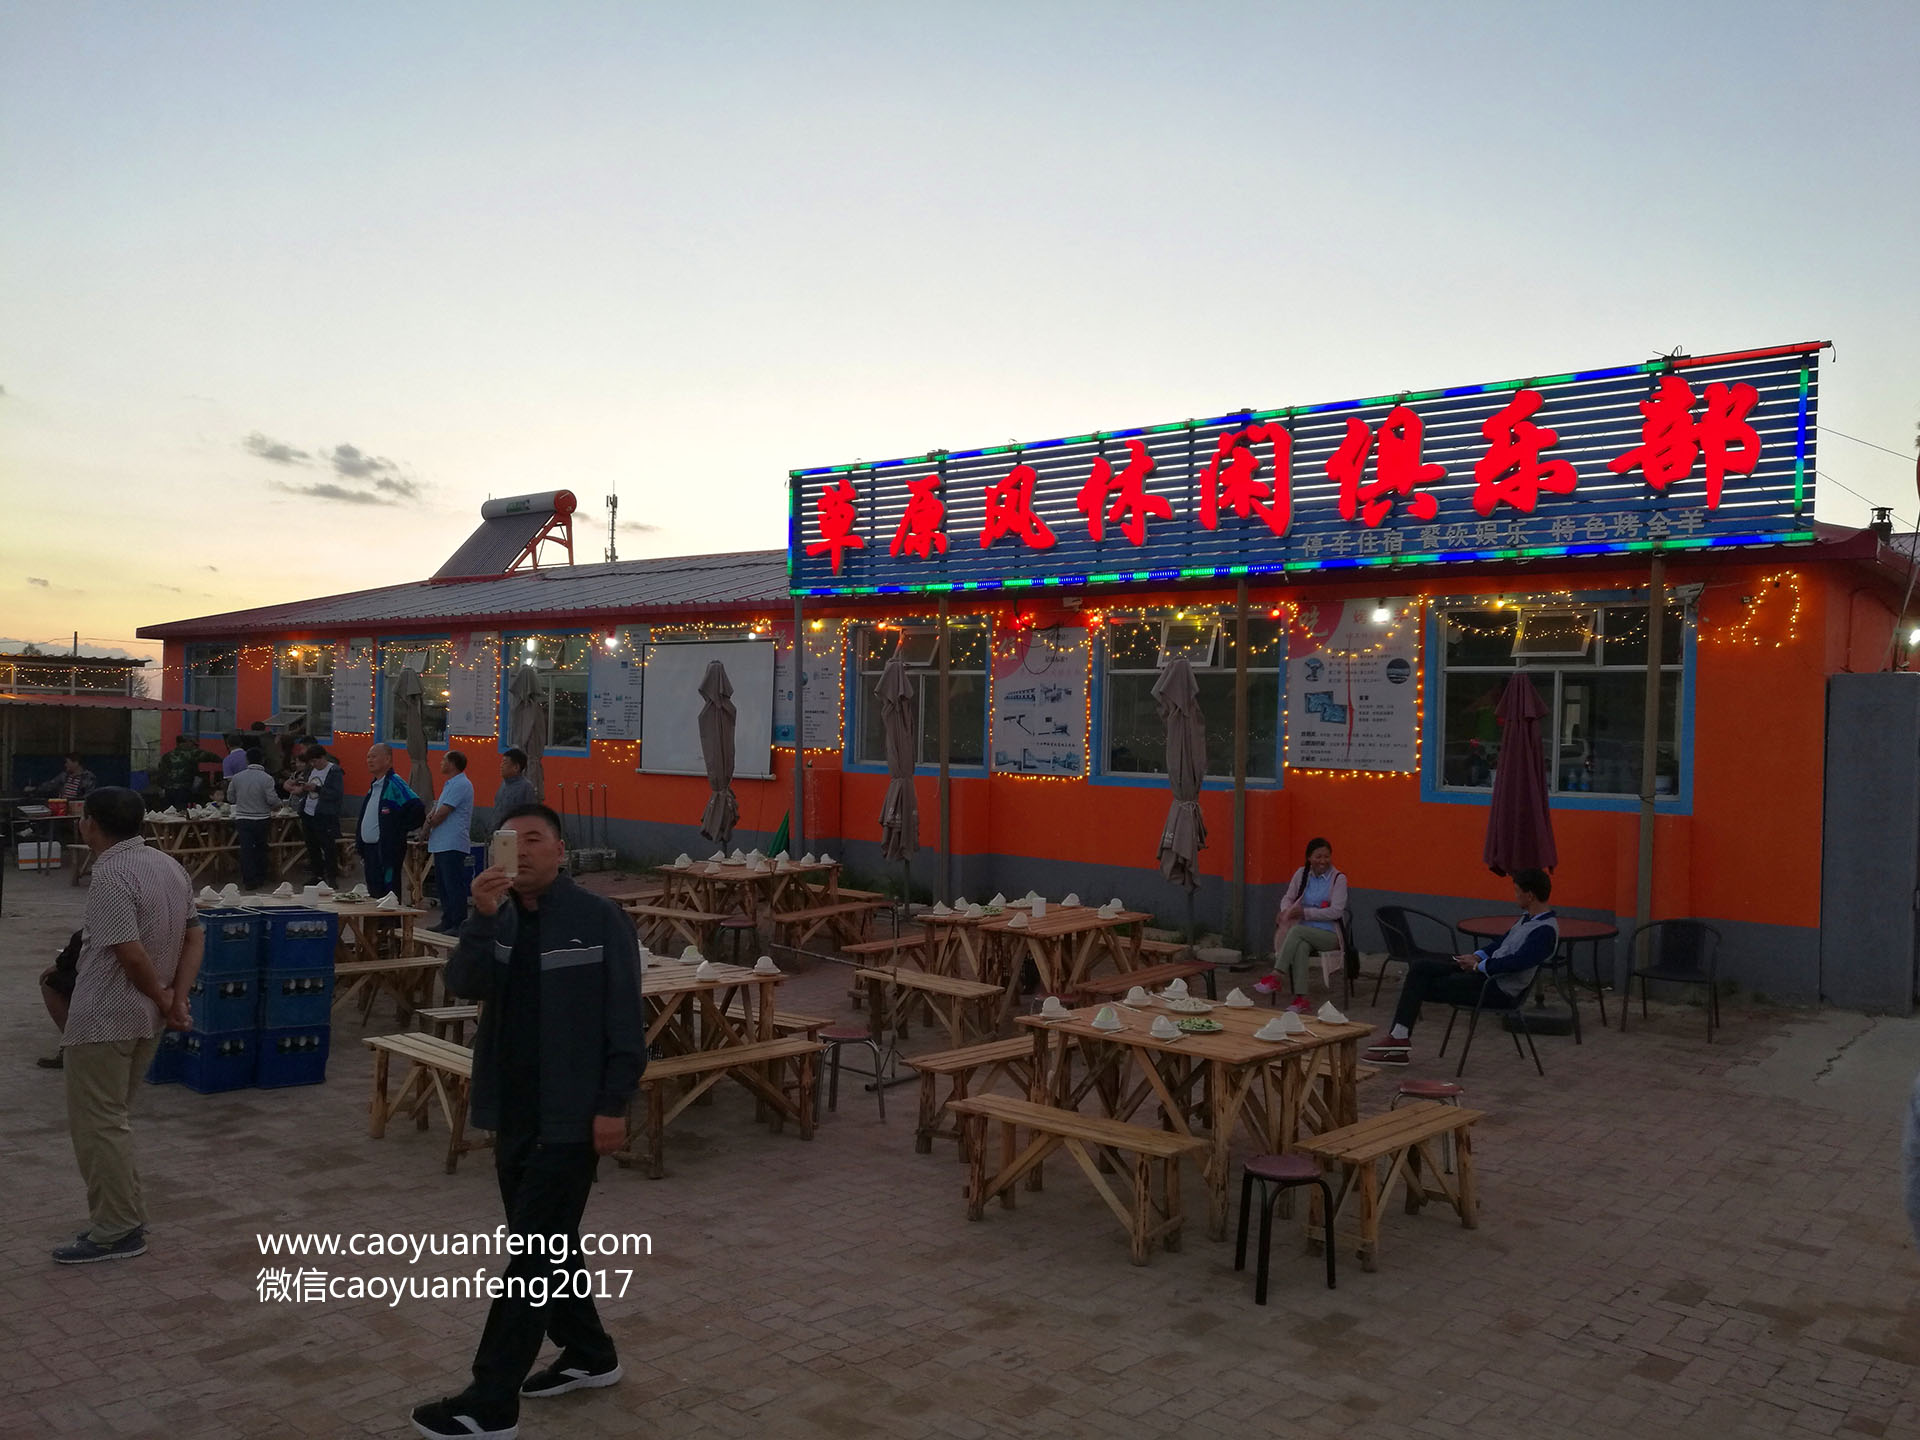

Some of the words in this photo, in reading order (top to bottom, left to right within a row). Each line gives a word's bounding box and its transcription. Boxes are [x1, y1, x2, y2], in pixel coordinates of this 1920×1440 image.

[806, 376, 1762, 576] 草原风休闲俱乐部
[1302, 532, 1403, 557] 停车住宿
[1419, 521, 1530, 551] 餐饮娱乐
[1551, 509, 1705, 541] 特色烤全羊
